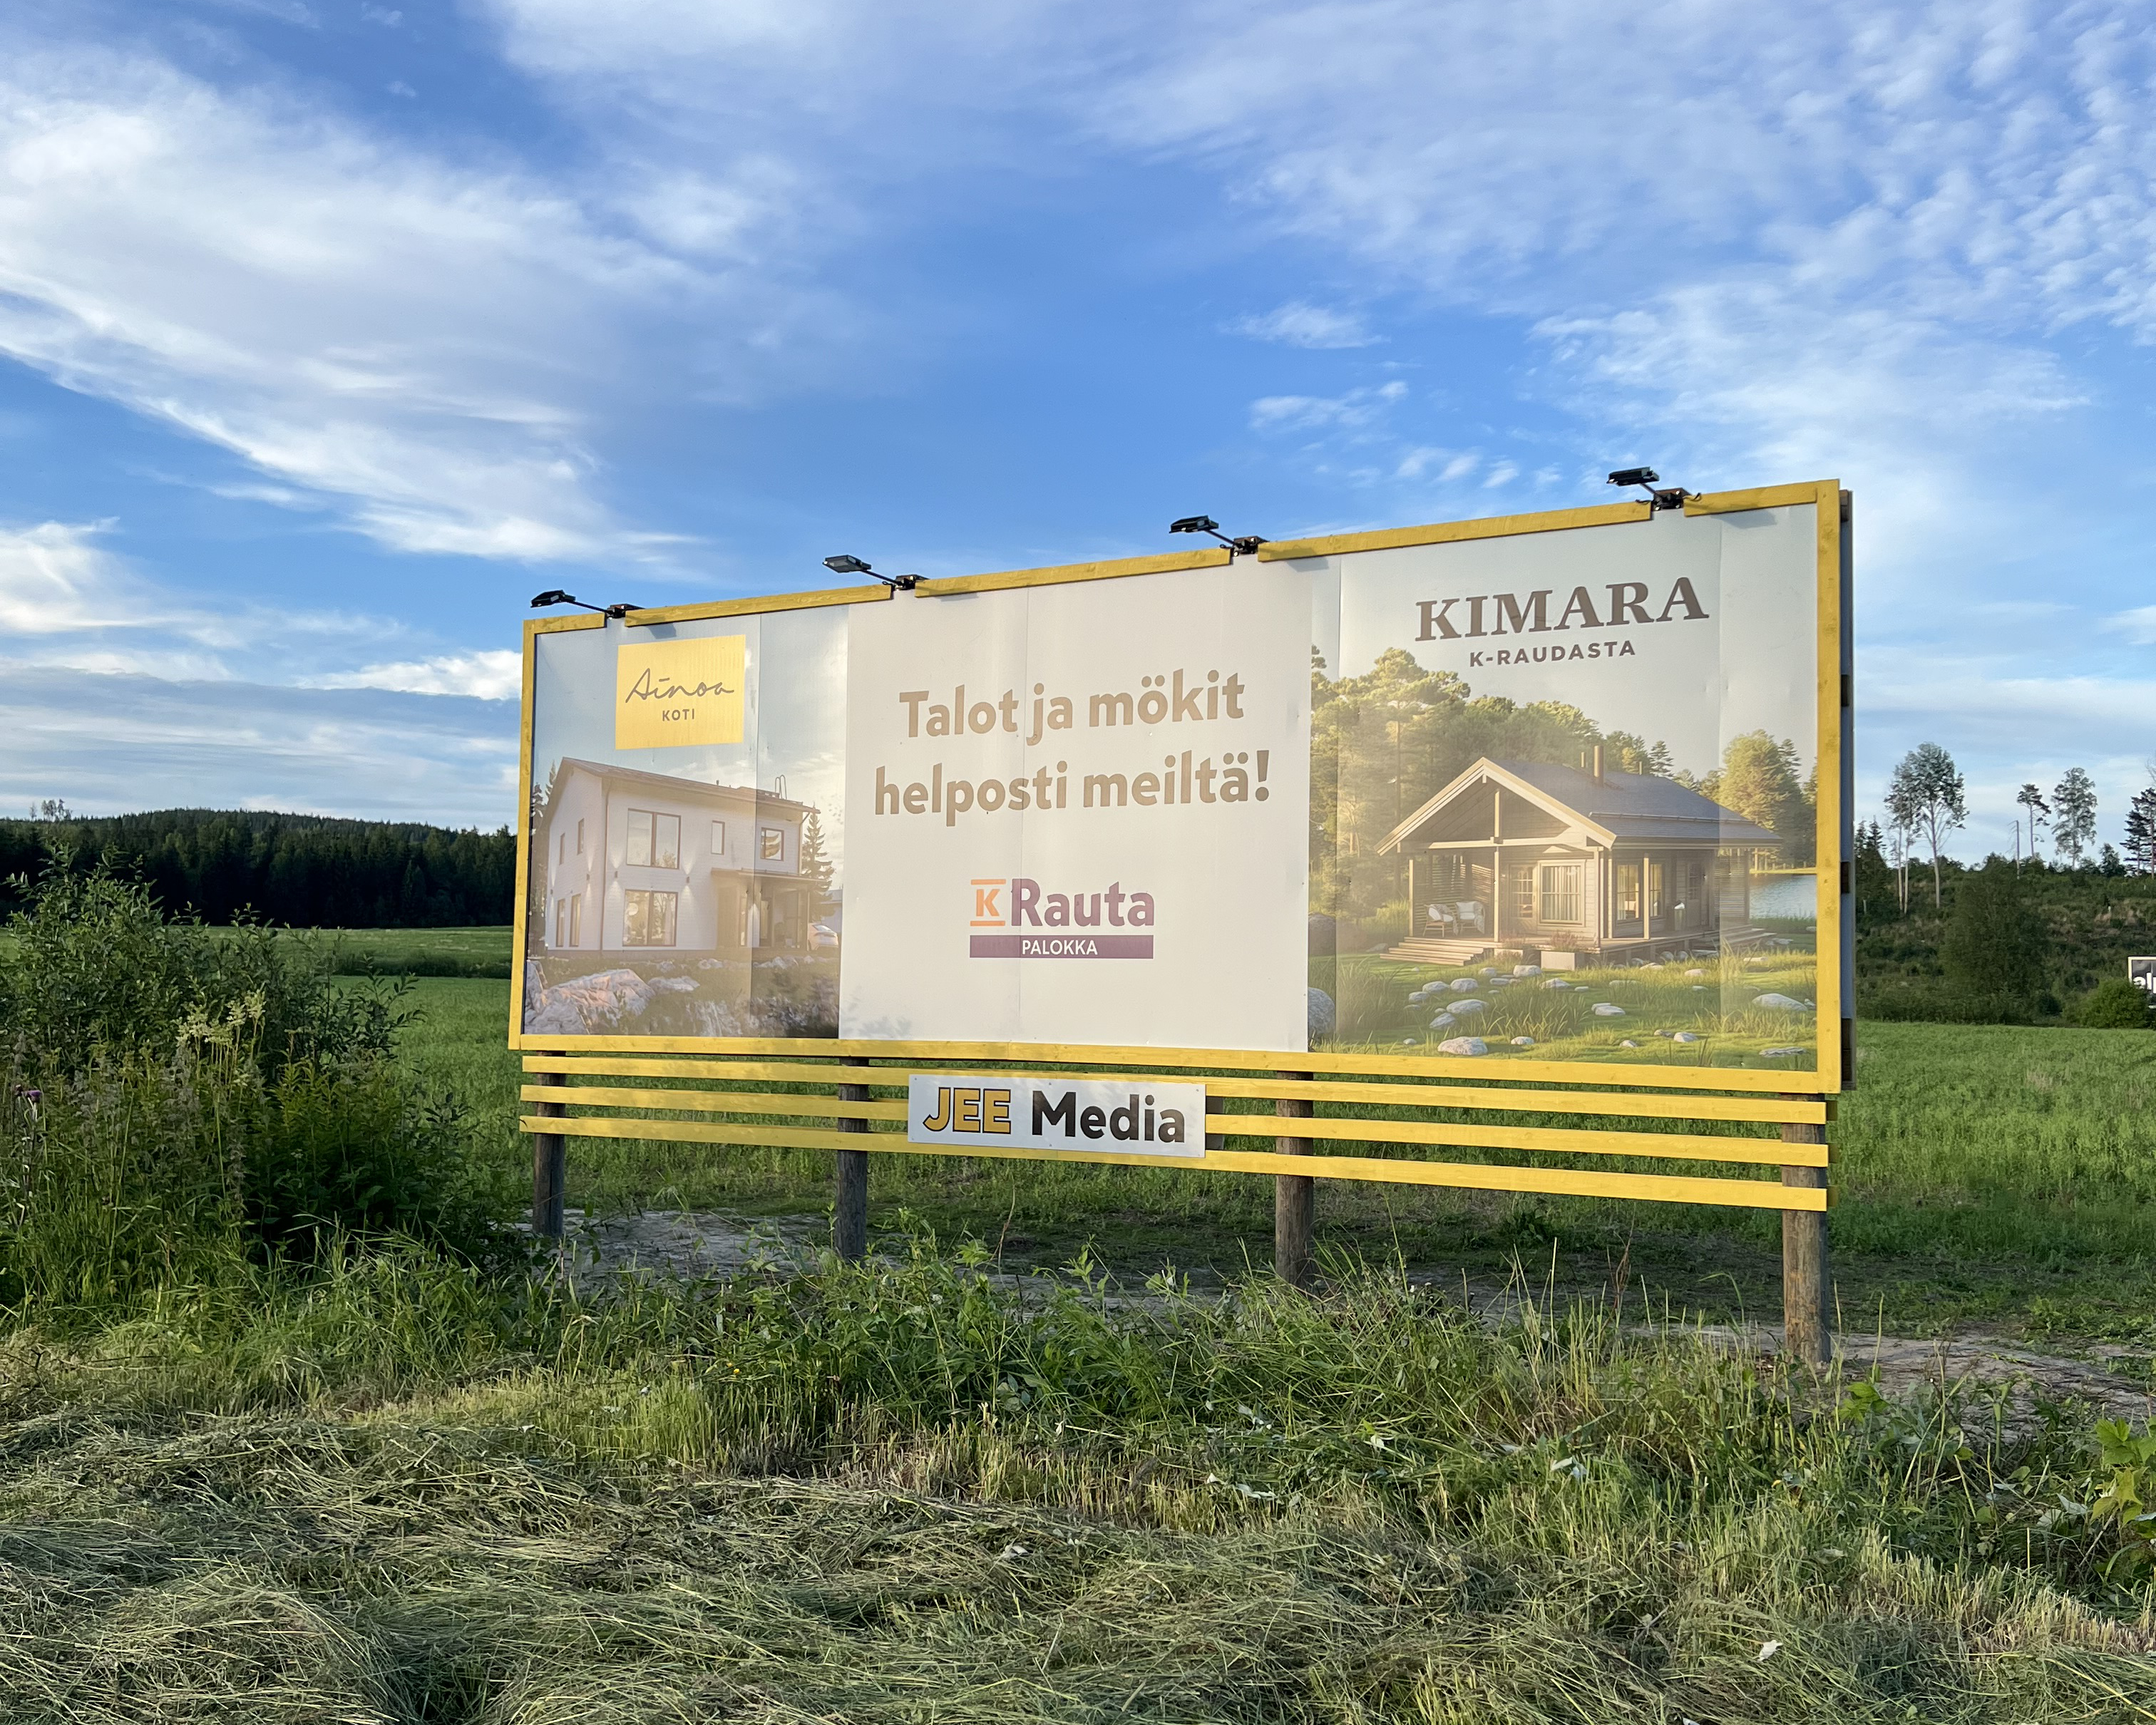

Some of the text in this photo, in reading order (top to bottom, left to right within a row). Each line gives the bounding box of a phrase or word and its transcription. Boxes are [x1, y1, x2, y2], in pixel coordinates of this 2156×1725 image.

[1415, 576, 1710, 642] KIMARA
[1469, 640, 1636, 667] K-RAUDASTA
[625, 667, 735, 704] Ainoa
[899, 668, 1246, 746] Talot ja mökit
[662, 708, 695, 722] KOTI
[874, 749, 1270, 827] helposti meiltä!
[1010, 878, 1155, 927] Rauta
[1021, 939, 1099, 956] PALOKKA
[923, 1086, 1185, 1143] JEE Media
